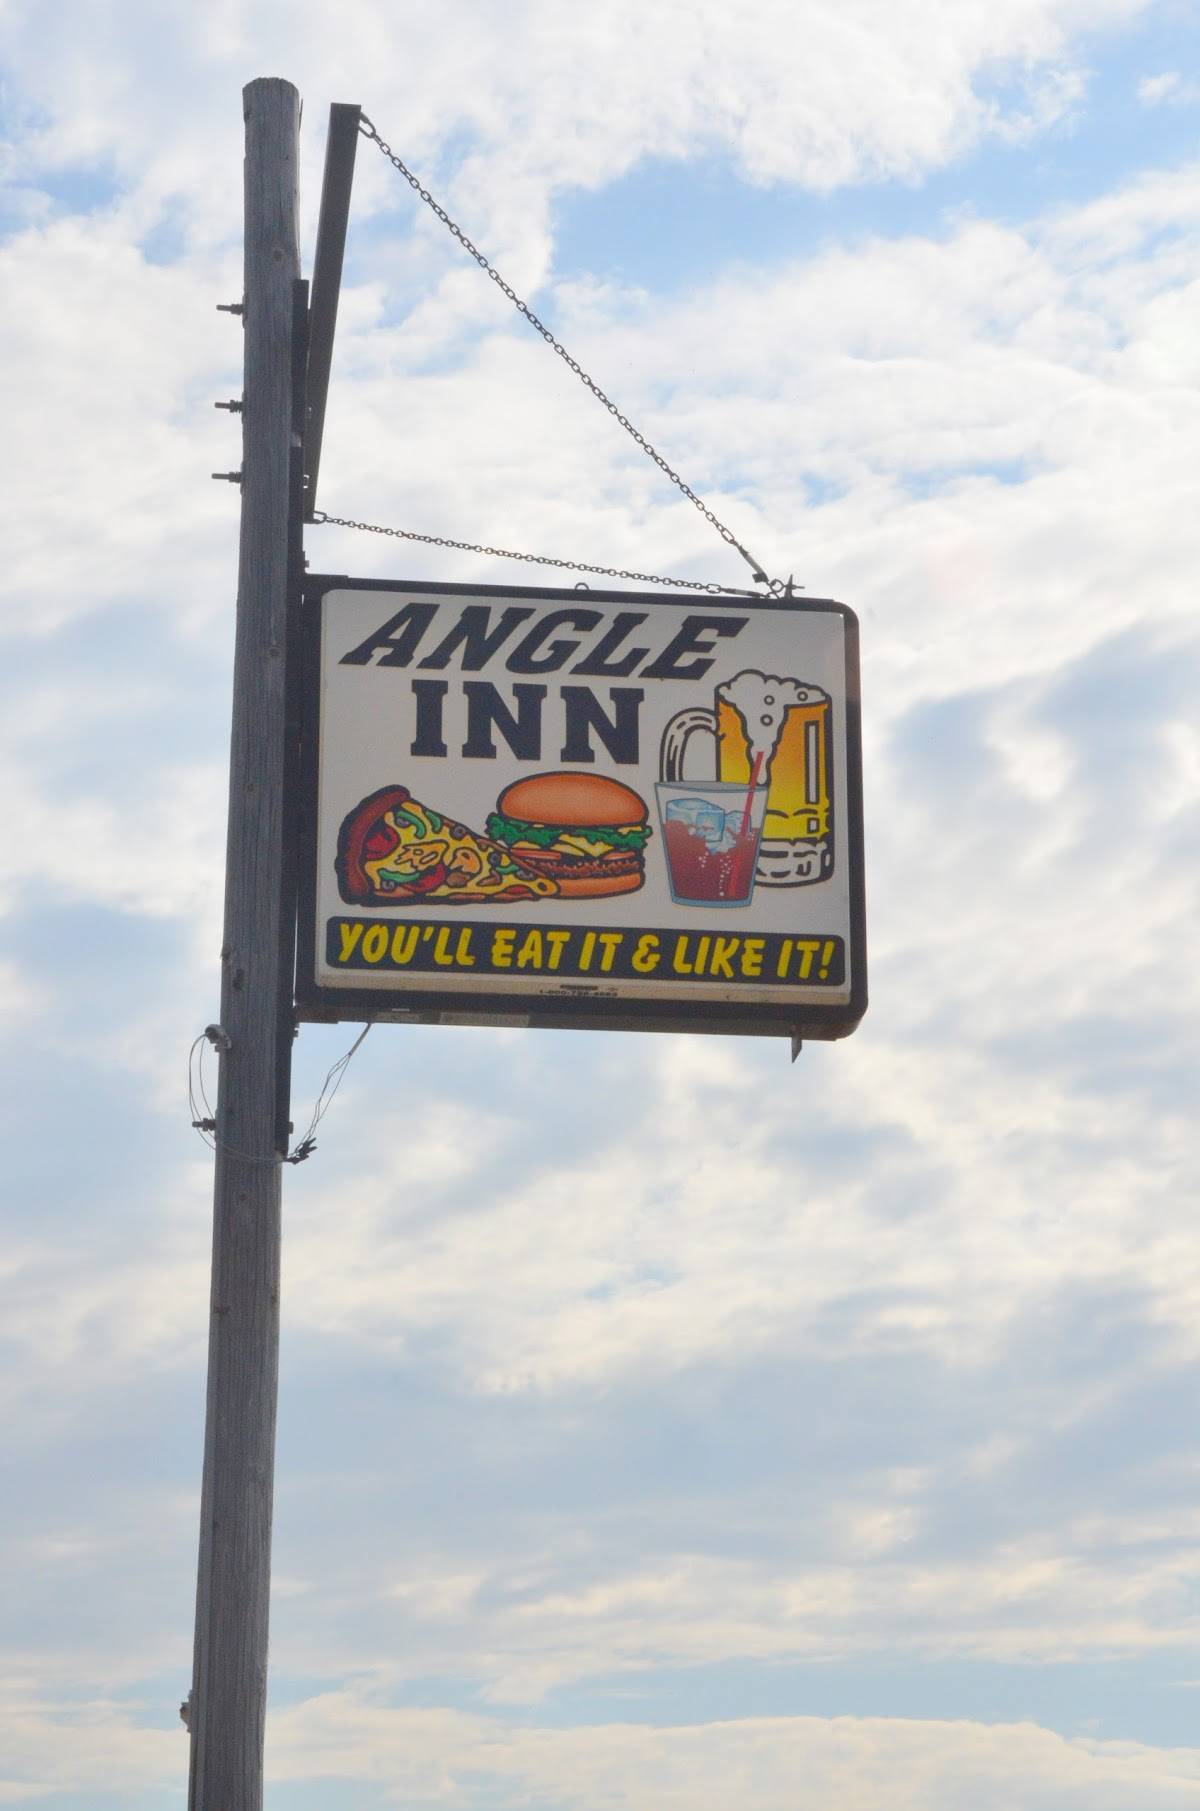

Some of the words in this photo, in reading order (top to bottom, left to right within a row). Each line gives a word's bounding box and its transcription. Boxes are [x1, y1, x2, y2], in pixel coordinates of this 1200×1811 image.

[338, 602, 749, 681] ANGLE
[410, 679, 645, 765] INN
[338, 923, 475, 966] YOU'LL
[492, 929, 571, 970] EAT
[579, 931, 623, 971] IT
[631, 934, 661, 973] &
[673, 935, 766, 978] LIKE
[777, 939, 835, 980] IT!
